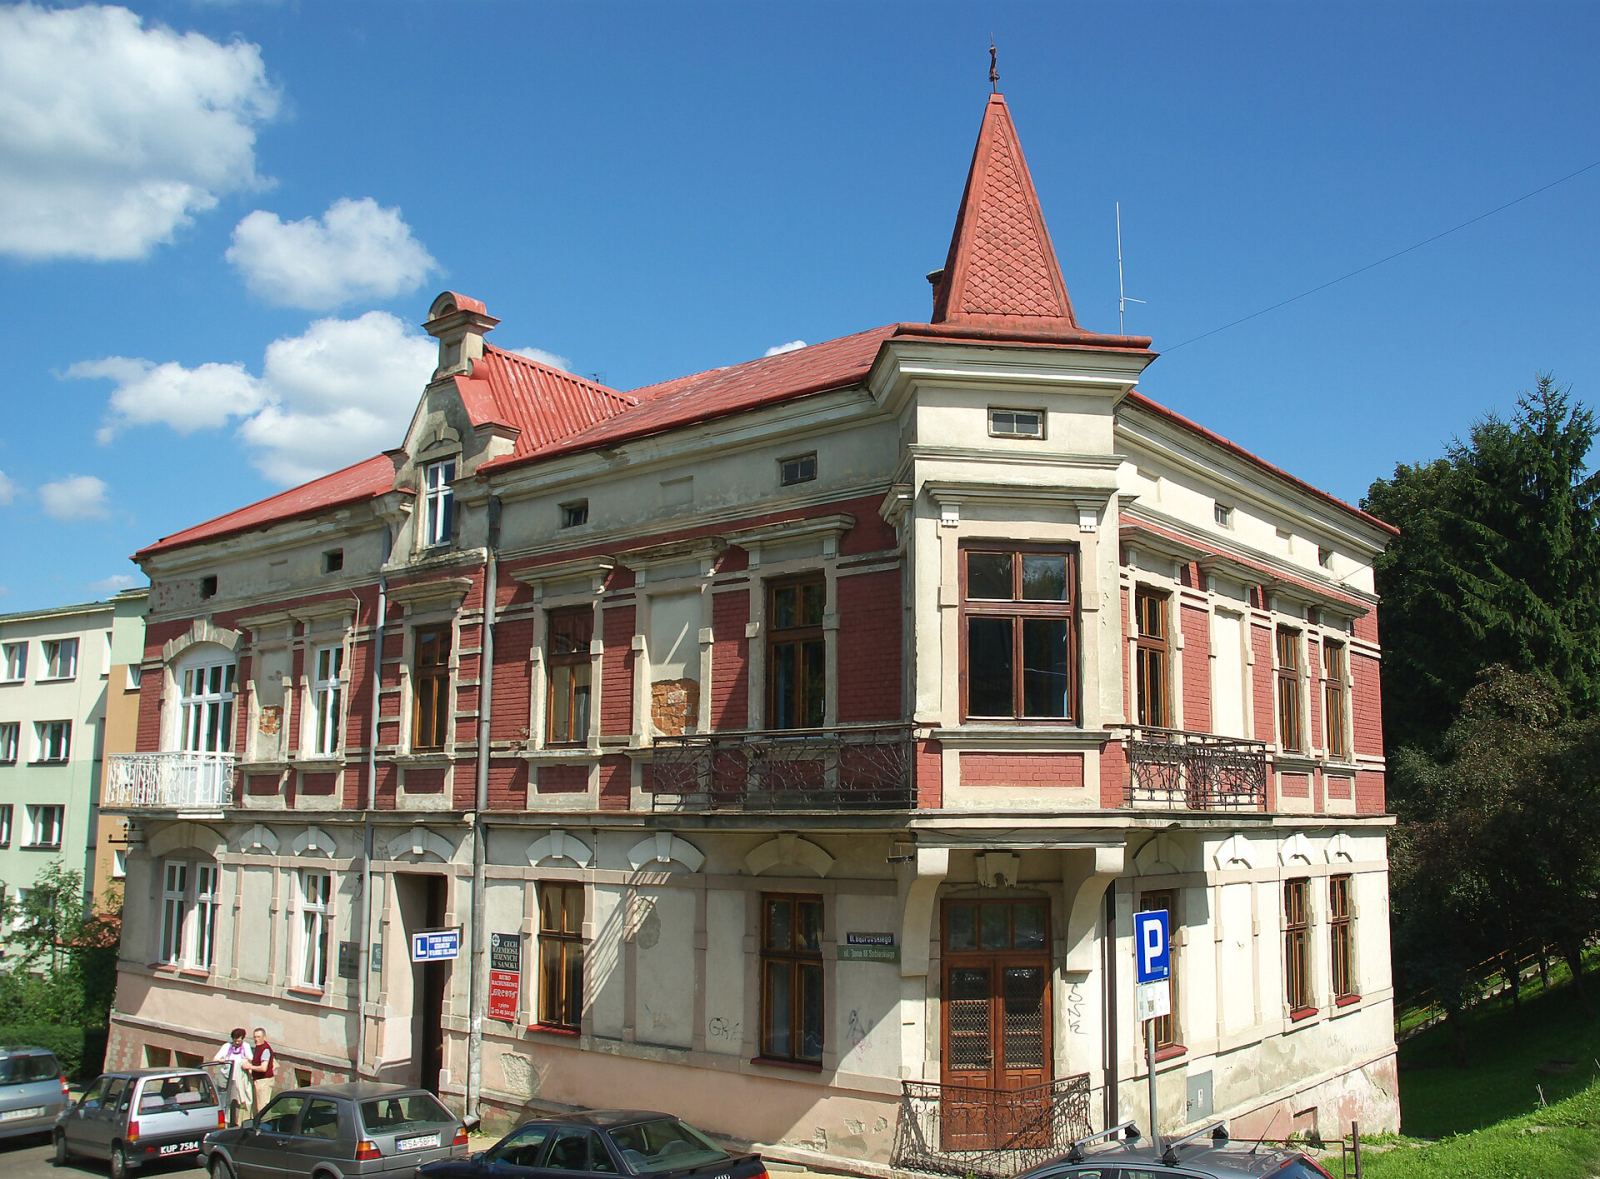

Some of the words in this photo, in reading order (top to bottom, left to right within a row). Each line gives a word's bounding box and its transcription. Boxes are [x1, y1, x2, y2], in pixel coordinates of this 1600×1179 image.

[417, 940, 427, 956] L
[1143, 919, 1164, 974] P
[161, 1144, 178, 1154] KUP
[180, 1141, 199, 1151] 7584
